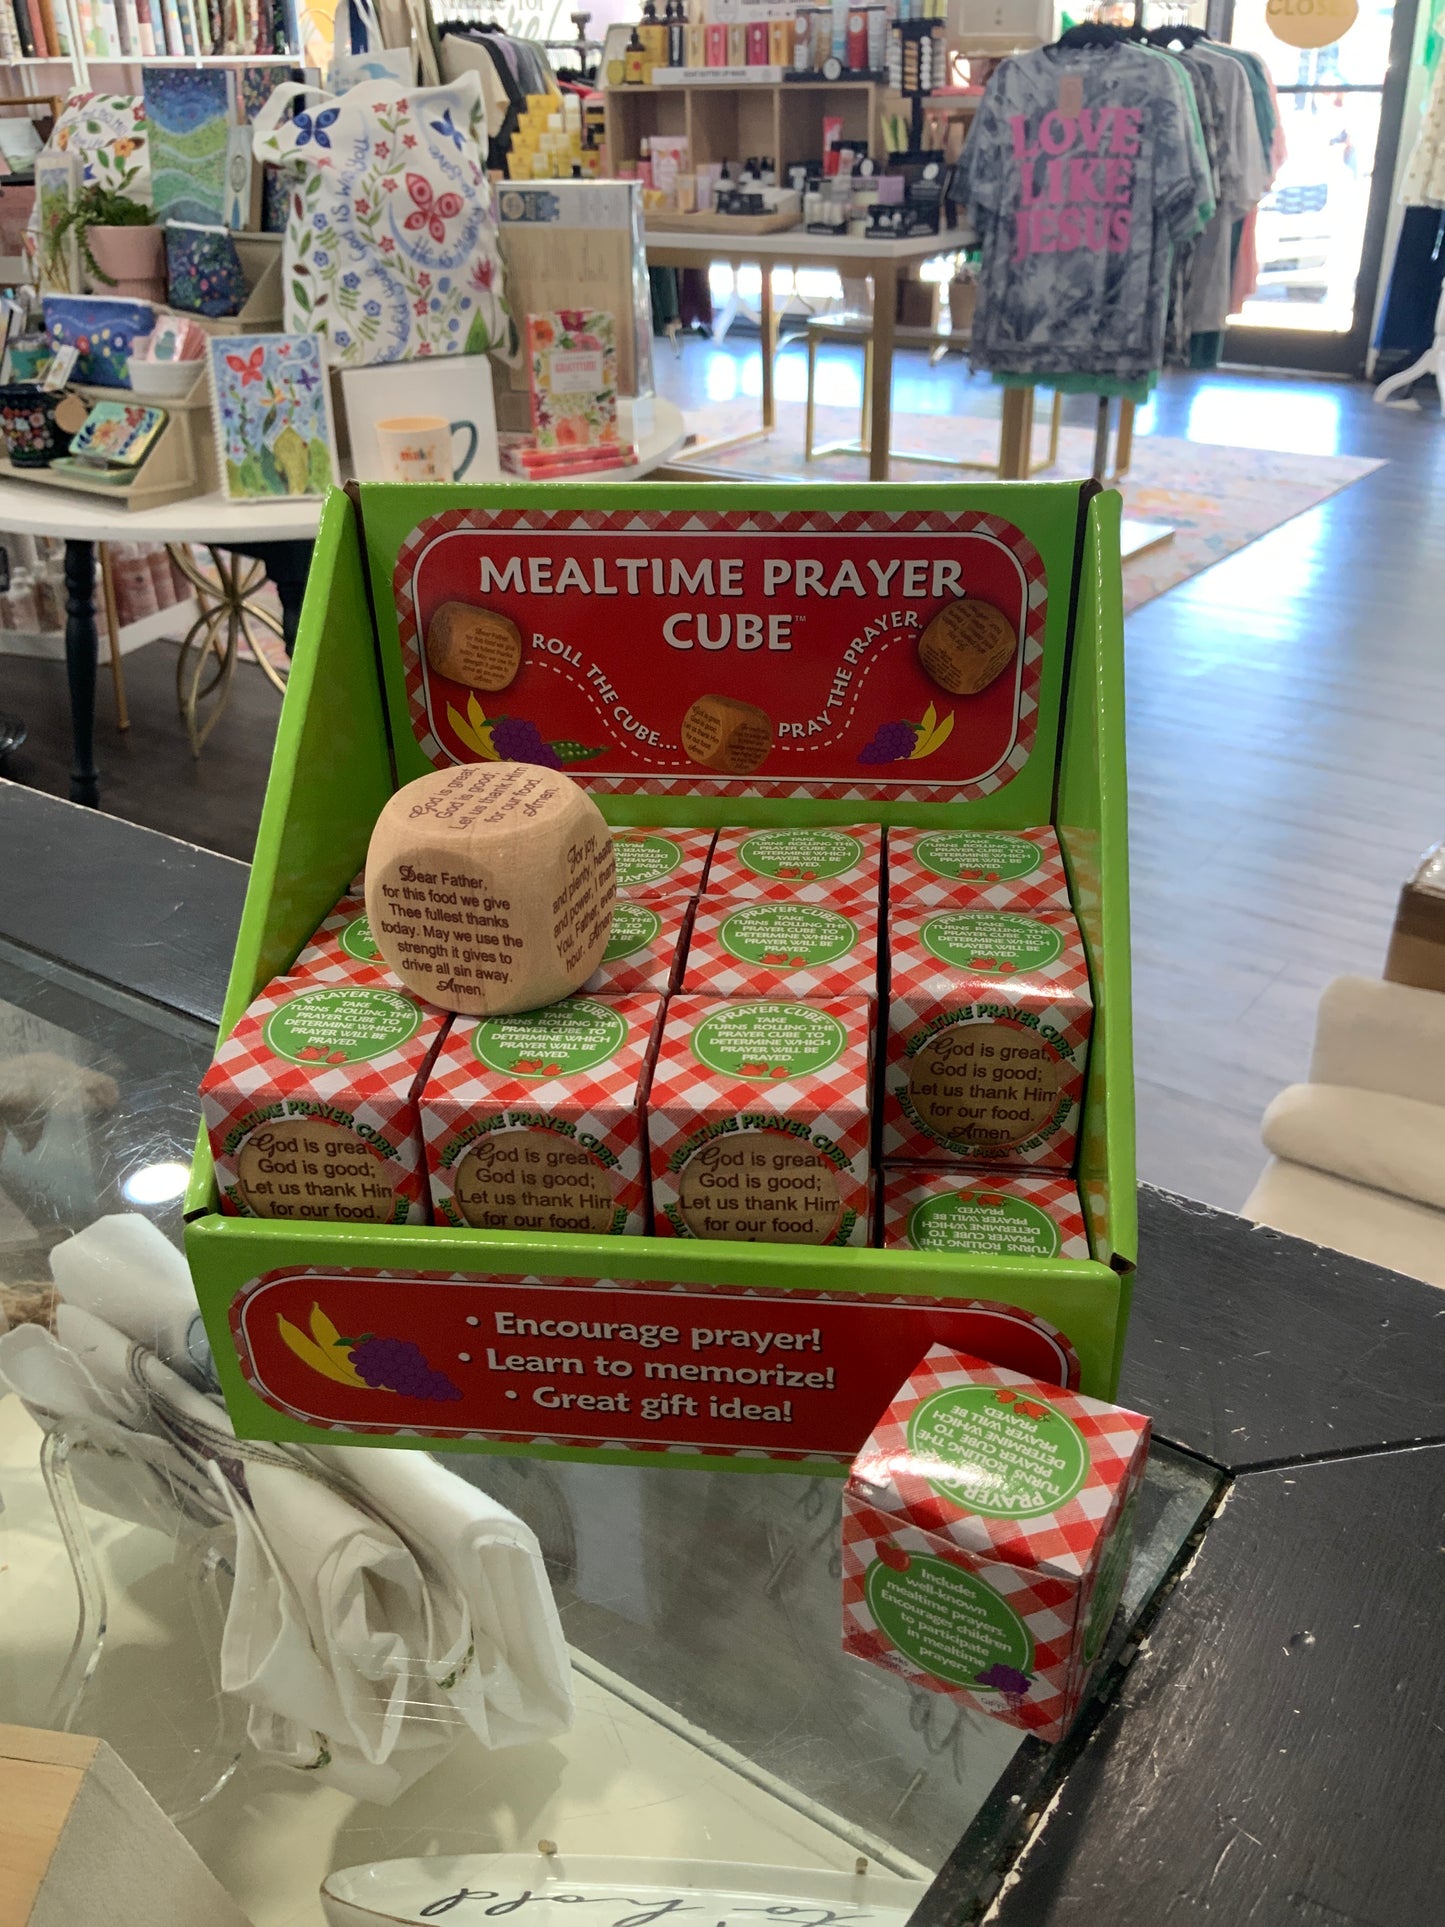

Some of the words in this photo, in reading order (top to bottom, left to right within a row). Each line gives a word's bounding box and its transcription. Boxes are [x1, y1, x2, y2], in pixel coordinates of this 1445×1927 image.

[1009, 108, 1143, 160] LOVE
[1021, 158, 1133, 206] LIKE
[1011, 206, 1132, 264] JESUS
[479, 556, 744, 596] MEALTIME
[763, 559, 966, 598] PRAYER
[532, 633, 582, 668] ROLL
[586, 663, 619, 704] THE
[778, 710, 832, 738] PRAY
[827, 667, 852, 708] THE
[502, 767, 528, 785] Him
[478, 782, 510, 803] thank
[409, 797, 443, 818] God
[436, 797, 464, 818] God
[470, 805, 487, 815] us
[484, 812, 506, 822] for
[502, 797, 522, 810] our
[448, 816, 472, 829] Let
[398, 864, 437, 885] Dear
[441, 872, 488, 891] Father,
[382, 885, 400, 899] for
[403, 887, 426, 902] this
[428, 889, 457, 905] food
[460, 896, 480, 908] we
[483, 896, 511, 912] give
[553, 886, 567, 914] and
[388, 903, 422, 919] Thee
[425, 907, 464, 924] fullest
[466, 912, 510, 929] thanks
[554, 911, 568, 938] and
[381, 920, 420, 938] today.
[423, 925, 451, 943] May
[453, 931, 473, 943] we
[476, 933, 500, 946] use
[502, 934, 524, 948] the
[397, 940, 449, 960] strength
[451, 945, 461, 959] it
[463, 947, 496, 965] gives
[498, 952, 513, 965] to
[402, 958, 433, 974] drive
[435, 961, 450, 975] all
[453, 963, 472, 977] sin
[475, 967, 513, 983] away.
[436, 977, 486, 997] Amen.
[716, 1006, 780, 1023] PRAYER
[904, 1006, 973, 1059] MEALTIME
[976, 1004, 1040, 1030] PRAYER
[926, 1038, 974, 1060] God
[981, 1043, 994, 1057] is
[930, 1061, 967, 1077] God
[973, 1063, 986, 1078] is
[993, 1066, 1042, 1082] good;
[911, 1082, 937, 1096] Let
[944, 1086, 963, 1097] us
[970, 1084, 1018, 1100] thank
[930, 1103, 952, 1116] for
[958, 1107, 987, 1118] our
[992, 1107, 1035, 1121] food.
[667, 1117, 739, 1174] MEALTIME
[741, 1113, 812, 1140] PRAYER
[948, 1122, 1015, 1140] Amen.
[249, 1133, 298, 1158] God
[304, 1139, 319, 1152] is
[258, 1159, 297, 1174] God
[303, 1160, 318, 1174] is
[324, 1162, 376, 1178] good;
[693, 1147, 744, 1171] God
[751, 1152, 765, 1166] is
[244, 1180, 274, 1194] Let
[279, 1184, 299, 1195] us
[306, 1181, 358, 1198] thank
[700, 1172, 739, 1187] God
[747, 1174, 760, 1188] is
[767, 1175, 821, 1191] good;
[270, 1201, 293, 1216] for
[300, 1205, 329, 1217] our
[334, 1204, 380, 1218] food.
[680, 1195, 711, 1210] Let
[717, 1198, 738, 1210] us
[746, 1196, 797, 1211] thank
[705, 1216, 729, 1231] for
[736, 1220, 766, 1232] our
[772, 1218, 819, 1233] food.
[494, 1311, 680, 1349] Encourage
[691, 1324, 822, 1354] prayer!
[486, 1348, 585, 1375] Learn
[594, 1355, 633, 1378] to
[644, 1363, 835, 1390] memorize!
[532, 1386, 630, 1412] Great
[640, 1392, 698, 1420] gift
[710, 1396, 793, 1422] idea!
[921, 1569, 977, 1599] Includes
[887, 1581, 948, 1613] mealtime
[951, 1610, 1007, 1637] prayers.
[906, 1577, 987, 1617] well-known
[881, 1589, 953, 1628] Encourages
[956, 1625, 1012, 1652] children
[901, 1612, 915, 1624] to
[918, 1621, 989, 1656] participate
[907, 1627, 919, 1639] in
[924, 1637, 985, 1667] mealtime
[920, 1647, 971, 1674] prayers.
